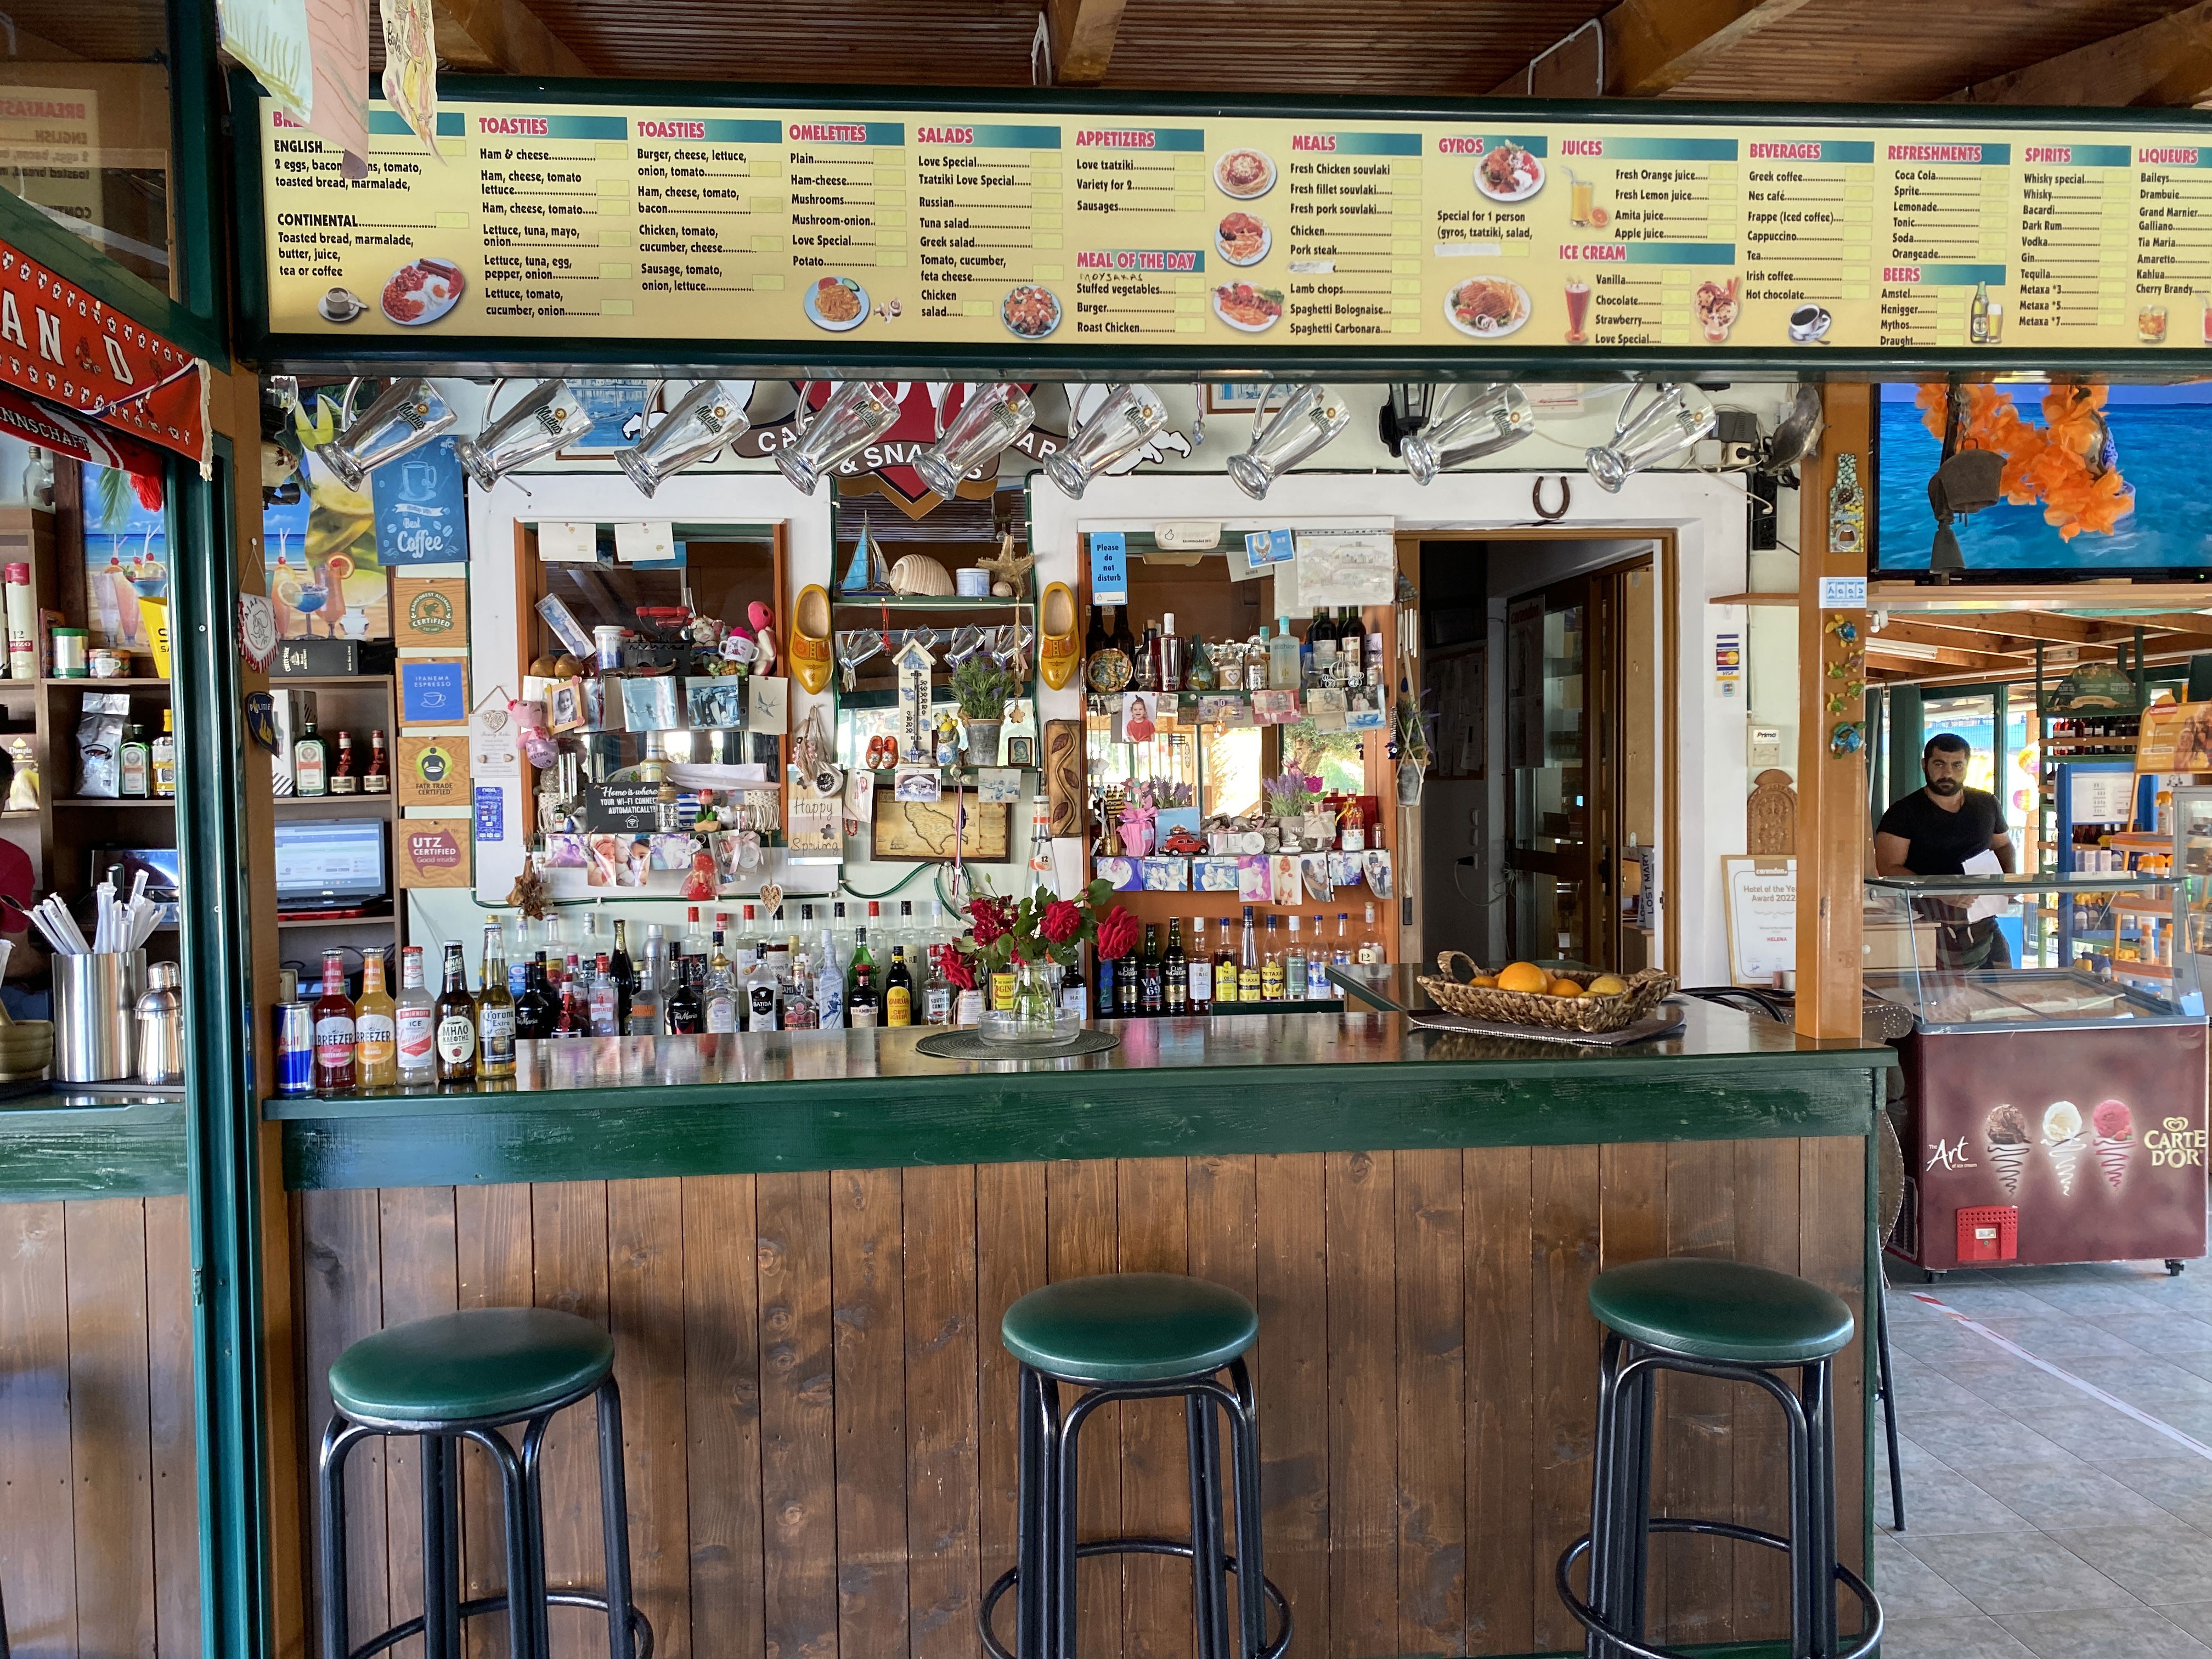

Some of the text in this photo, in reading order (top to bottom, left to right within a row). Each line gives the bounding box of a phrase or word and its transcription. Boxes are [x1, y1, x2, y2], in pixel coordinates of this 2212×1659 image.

[479, 117, 548, 136] TOASTIES
[637, 122, 705, 138] TOASTIES
[789, 125, 866, 141] OMELETTES
[918, 128, 973, 144] SALADS
[1076, 131, 1155, 147] APPETIZERS
[274, 140, 323, 153] ENGLISH
[1292, 136, 1335, 150] MEALS
[1439, 138, 1483, 153] GYROS
[1562, 140, 1602, 155] JUICES
[480, 149, 549, 160] Ham & cheese
[637, 149, 747, 163] Burger, cheese, lettuce,
[1750, 143, 1820, 159] BEVERAGES
[1888, 145, 1982, 161] REFRESHMENTS
[2025, 148, 2070, 162] SPIRITS
[2139, 148, 2197, 163] LIQUEURS
[791, 153, 814, 164] Plain
[918, 156, 977, 168] Love Special
[1290, 163, 1390, 175] Fresh Chicken souvlaki
[1894, 171, 1936, 180] Coca Cola
[791, 176, 847, 185] Ham-cheese
[1616, 170, 1696, 182] Fresh Orange juice
[1749, 171, 1803, 182] Greek coffee
[2024, 174, 2084, 186] Whisky special
[2141, 173, 2169, 184] Baileys
[792, 195, 844, 205] Mushrooms
[919, 197, 954, 207] Russian
[1077, 201, 1118, 213] Sausages
[2023, 205, 2055, 215] Bacardi
[278, 214, 358, 227] CONTINENTAL
[1437, 210, 1525, 223] Special for 1 person
[1893, 218, 1916, 228] Tonic
[483, 225, 580, 239] Lettuce, tuna, mayo,
[1290, 226, 1324, 236] Chicken
[2139, 222, 2173, 230] Galliano
[921, 238, 975, 247] Greek salad
[1748, 230, 1797, 243] Cappuccino
[2022, 236, 2048, 246] Vodka
[278, 248, 340, 261] butter, juice,
[1290, 245, 1337, 255] Pork steak
[1560, 245, 1626, 261] ICE CREAM
[793, 256, 824, 267] Potato
[1077, 252, 1196, 269] MEAL OF THE DAY
[280, 266, 343, 276] tea or coffee
[1883, 268, 1920, 281] BEERS
[1596, 274, 1626, 285] Vanilla
[1882, 289, 1910, 298] Amstel
[1596, 314, 1642, 326] Strawberry
[1881, 319, 1910, 331] Mythos
[1077, 323, 1140, 332] Roast Chicken
[396, 402, 427, 431] Mythos
[534, 405, 564, 436] Mythos
[695, 405, 723, 435] Mythos
[852, 400, 878, 429] Mythos
[990, 402, 1015, 431] Mythos
[1125, 405, 1149, 435] Mythos
[1308, 407, 1332, 435] Mythos
[1492, 408, 1513, 437] Mythos
[398, 529, 443, 558] Coffee
[411, 592, 433, 611] RAINFOREST
[413, 618, 450, 627] CERTIFIED
[13, 630, 24, 639] 12
[601, 786, 627, 797] Home
[794, 799, 832, 821] Happy
[413, 837, 442, 848] UTZ
[791, 837, 839, 857] Spring
[1642, 854, 1654, 914] LOST MARY
[1361, 953, 1370, 962] 12
[1146, 986, 1160, 995] 69
[484, 1010, 514, 1022] Corona
[318, 1033, 353, 1046] BREEZER
[2144, 1130, 2207, 1150] CARTE
[1926, 1136, 1968, 1171] Art
